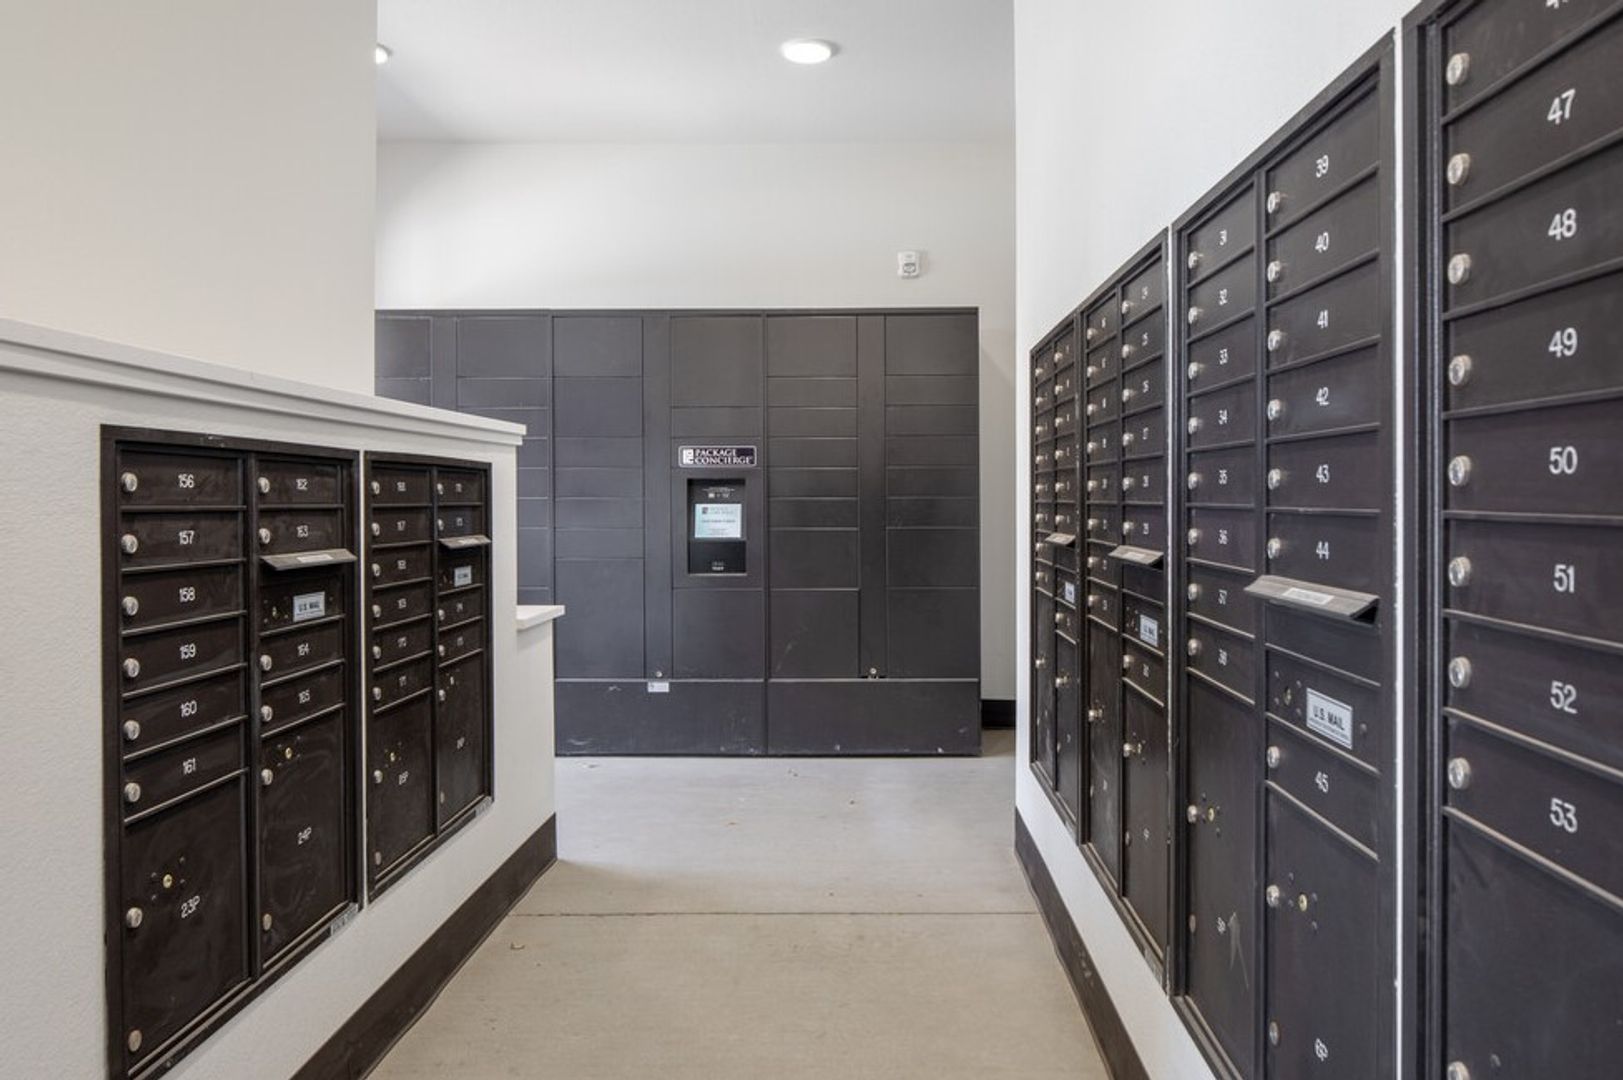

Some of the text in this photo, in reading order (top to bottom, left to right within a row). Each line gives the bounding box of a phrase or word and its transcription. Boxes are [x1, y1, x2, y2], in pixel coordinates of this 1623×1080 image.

[1548, 89, 1575, 124] 47
[1316, 155, 1328, 177] 39
[1548, 209, 1576, 240] 48
[1315, 232, 1329, 252] 40
[1318, 310, 1328, 328] 41
[1549, 328, 1577, 357] 49
[1316, 387, 1329, 405] 42
[694, 448, 736, 457] PACKAGE
[694, 456, 751, 465] CONCIERGE
[1549, 446, 1577, 474] 50
[178, 474, 194, 488] 156
[1316, 464, 1329, 483] 43
[179, 531, 194, 544] 157
[1316, 541, 1329, 559] 44
[1554, 564, 1574, 592] 51
[180, 587, 195, 602] 158
[180, 643, 196, 659] 159
[1551, 681, 1577, 713] 52
[181, 700, 197, 717] 160
[1327, 711, 1345, 731] MAIL
[183, 758, 196, 774] 161
[1315, 772, 1328, 792] 45
[1550, 798, 1577, 832] 53
[181, 896, 200, 918] 23P
